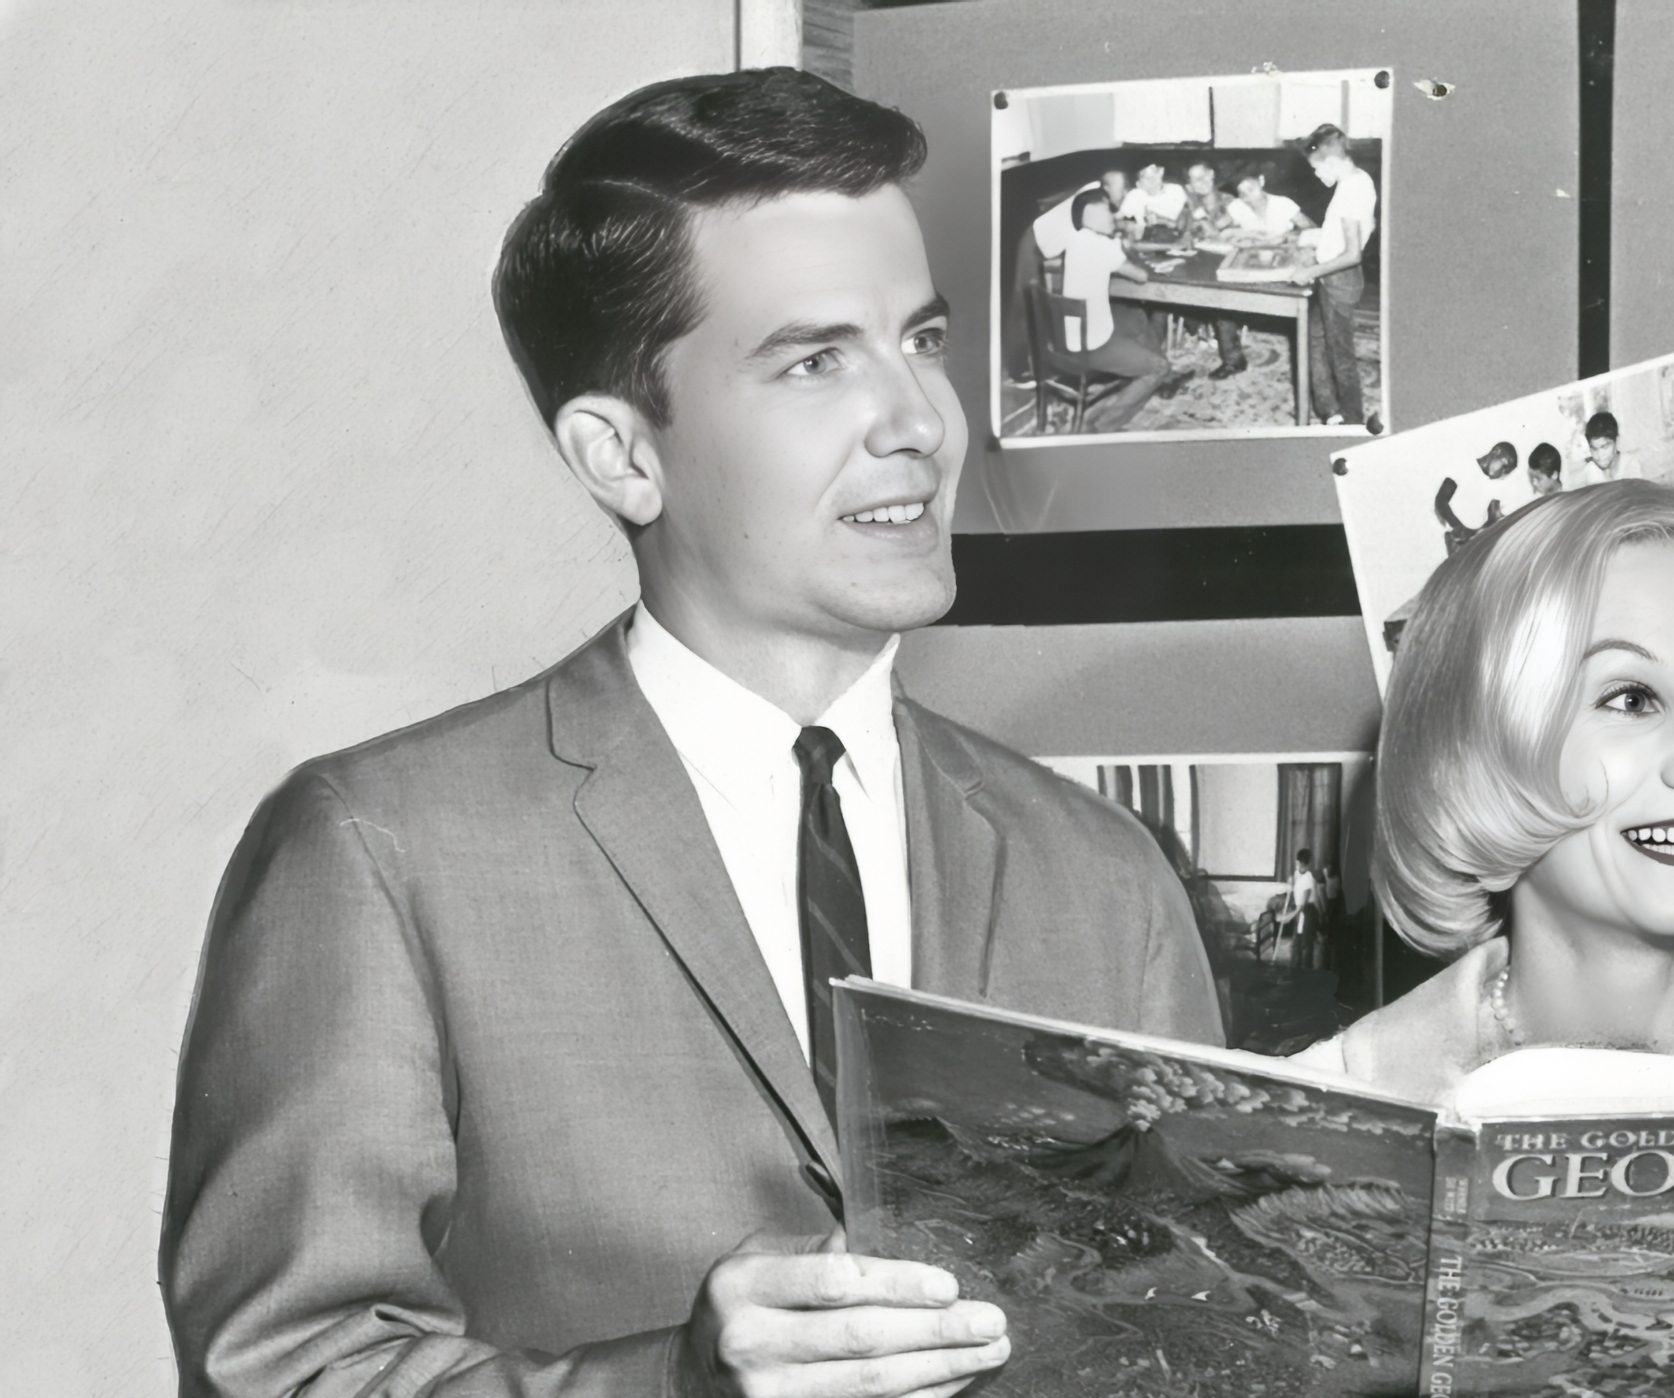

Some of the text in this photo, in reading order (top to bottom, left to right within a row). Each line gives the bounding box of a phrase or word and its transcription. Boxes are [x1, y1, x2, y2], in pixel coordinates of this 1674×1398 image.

[1496, 1132, 1568, 1151] THE
[1440, 1254, 1464, 1291] THE
[1432, 1296, 1460, 1367] GOLDEN
